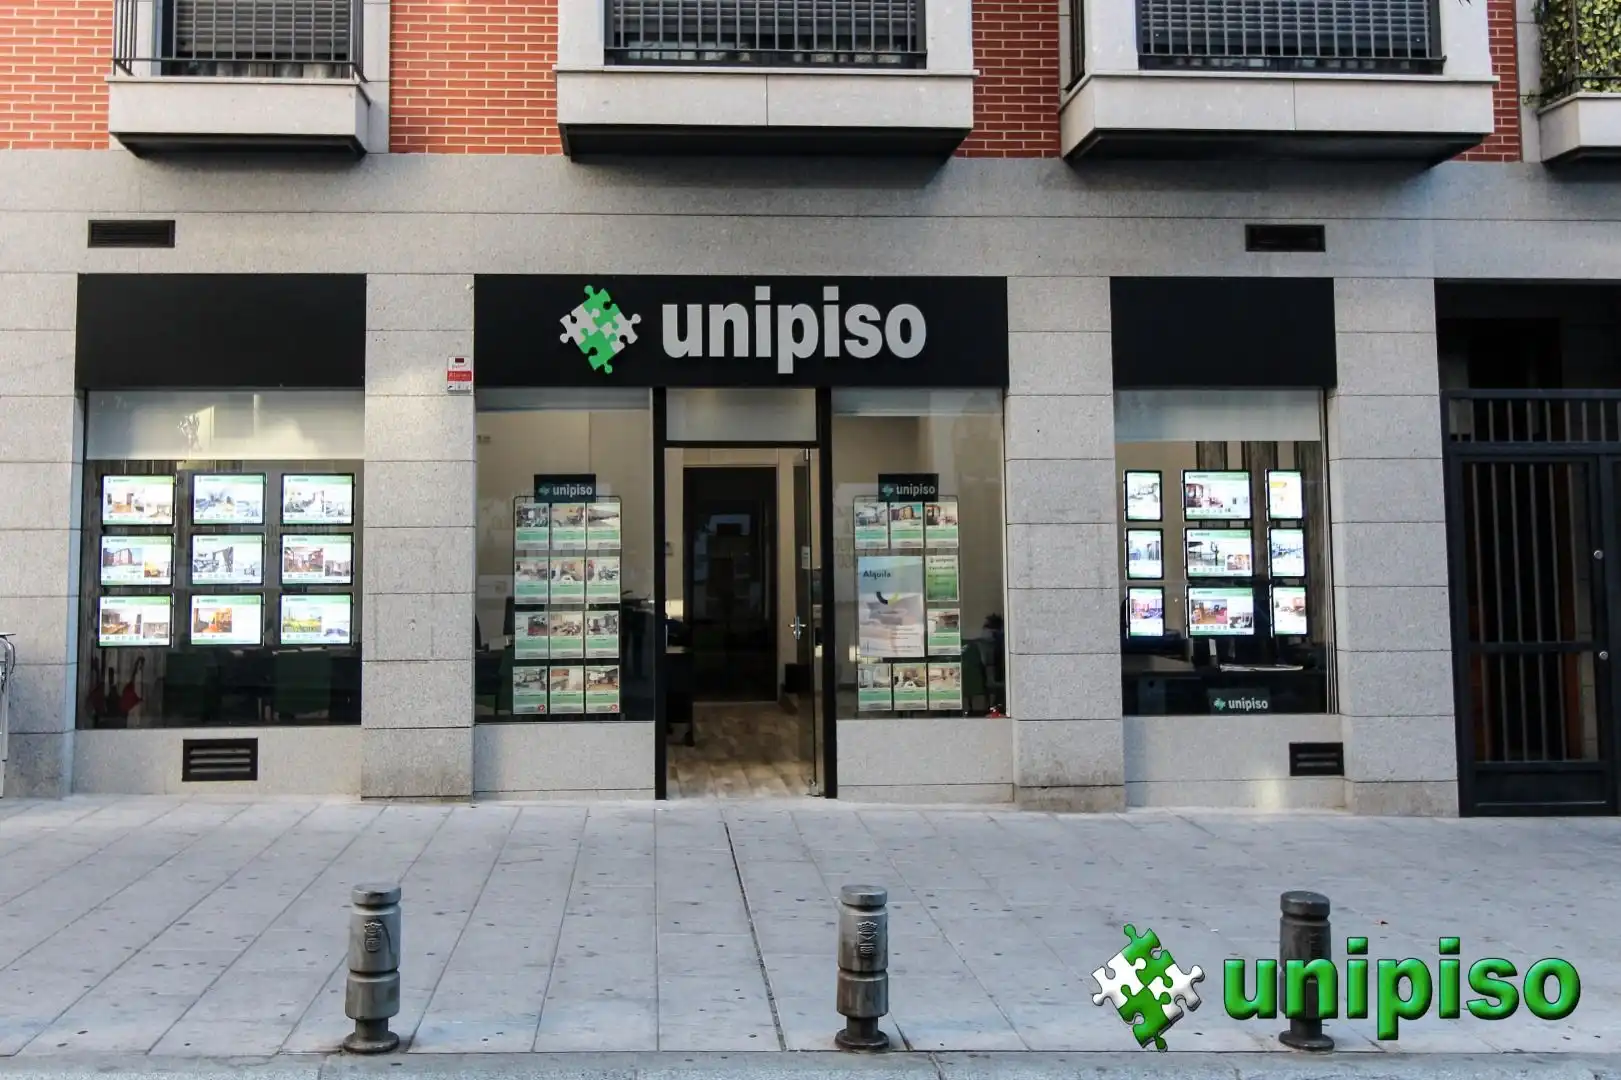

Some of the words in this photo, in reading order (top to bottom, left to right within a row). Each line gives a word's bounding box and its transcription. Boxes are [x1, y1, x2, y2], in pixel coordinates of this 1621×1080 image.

[662, 285, 927, 374] unipiso
[552, 484, 593, 498] unipiso
[896, 483, 936, 497] unipiso
[863, 569, 891, 580] Alquila
[1228, 697, 1268, 711] unipiso
